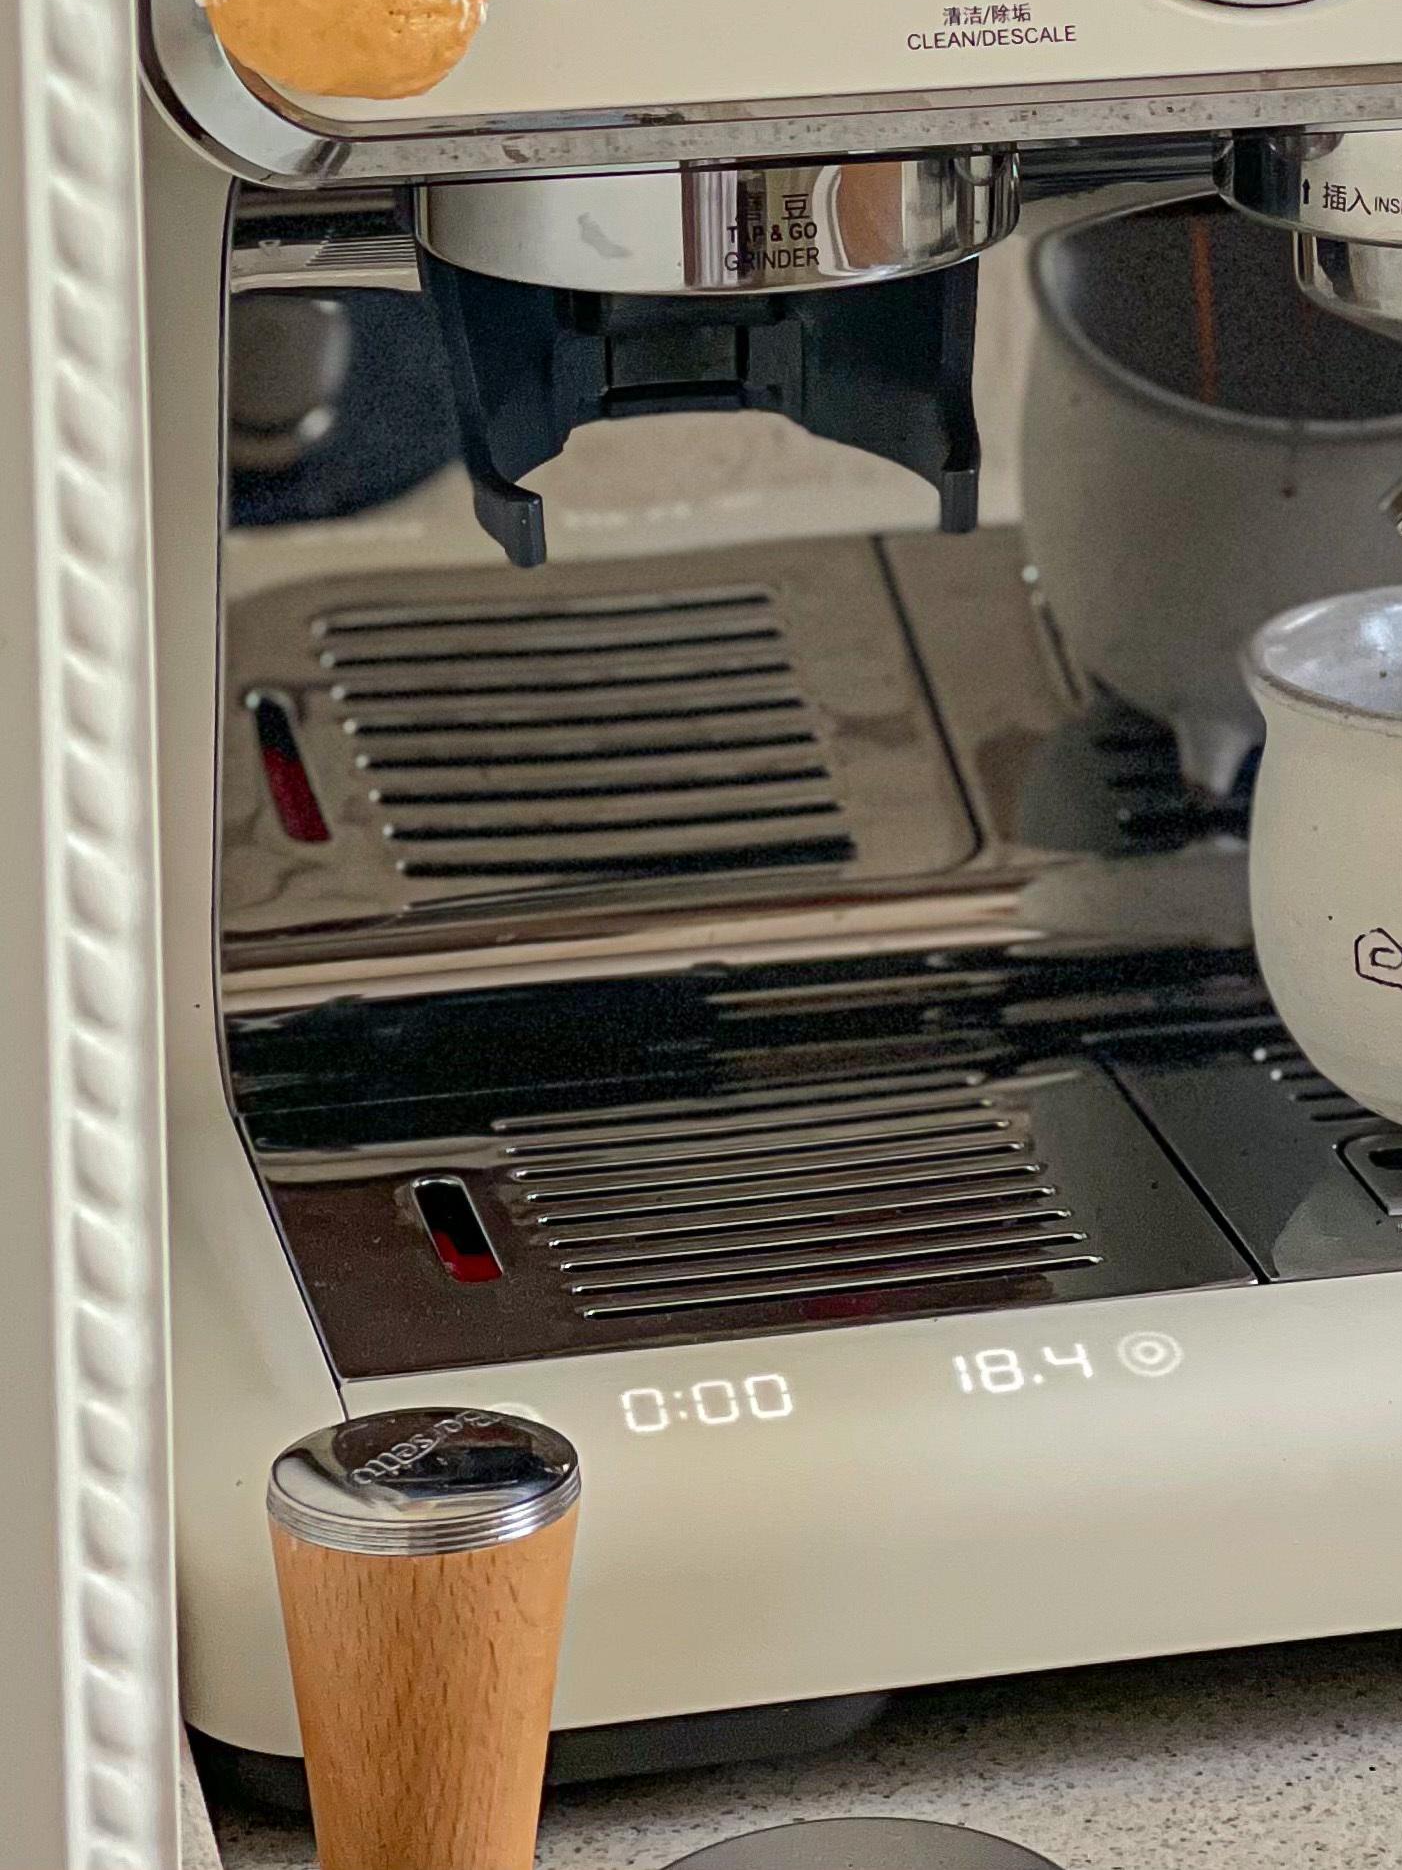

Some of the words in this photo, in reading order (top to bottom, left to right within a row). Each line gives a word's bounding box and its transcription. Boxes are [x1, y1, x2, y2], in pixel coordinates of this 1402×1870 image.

[942, 2, 1031, 27] 清洁/除垢
[907, 25, 1078, 50] CLEAN/DESCALE
[1322, 181, 1372, 216] 插入
[770, 224, 783, 242] &
[788, 221, 818, 241] GO
[724, 246, 820, 272] GRINDER
[952, 1343, 1095, 1394] 18.4
[619, 1373, 793, 1432] 0:00
